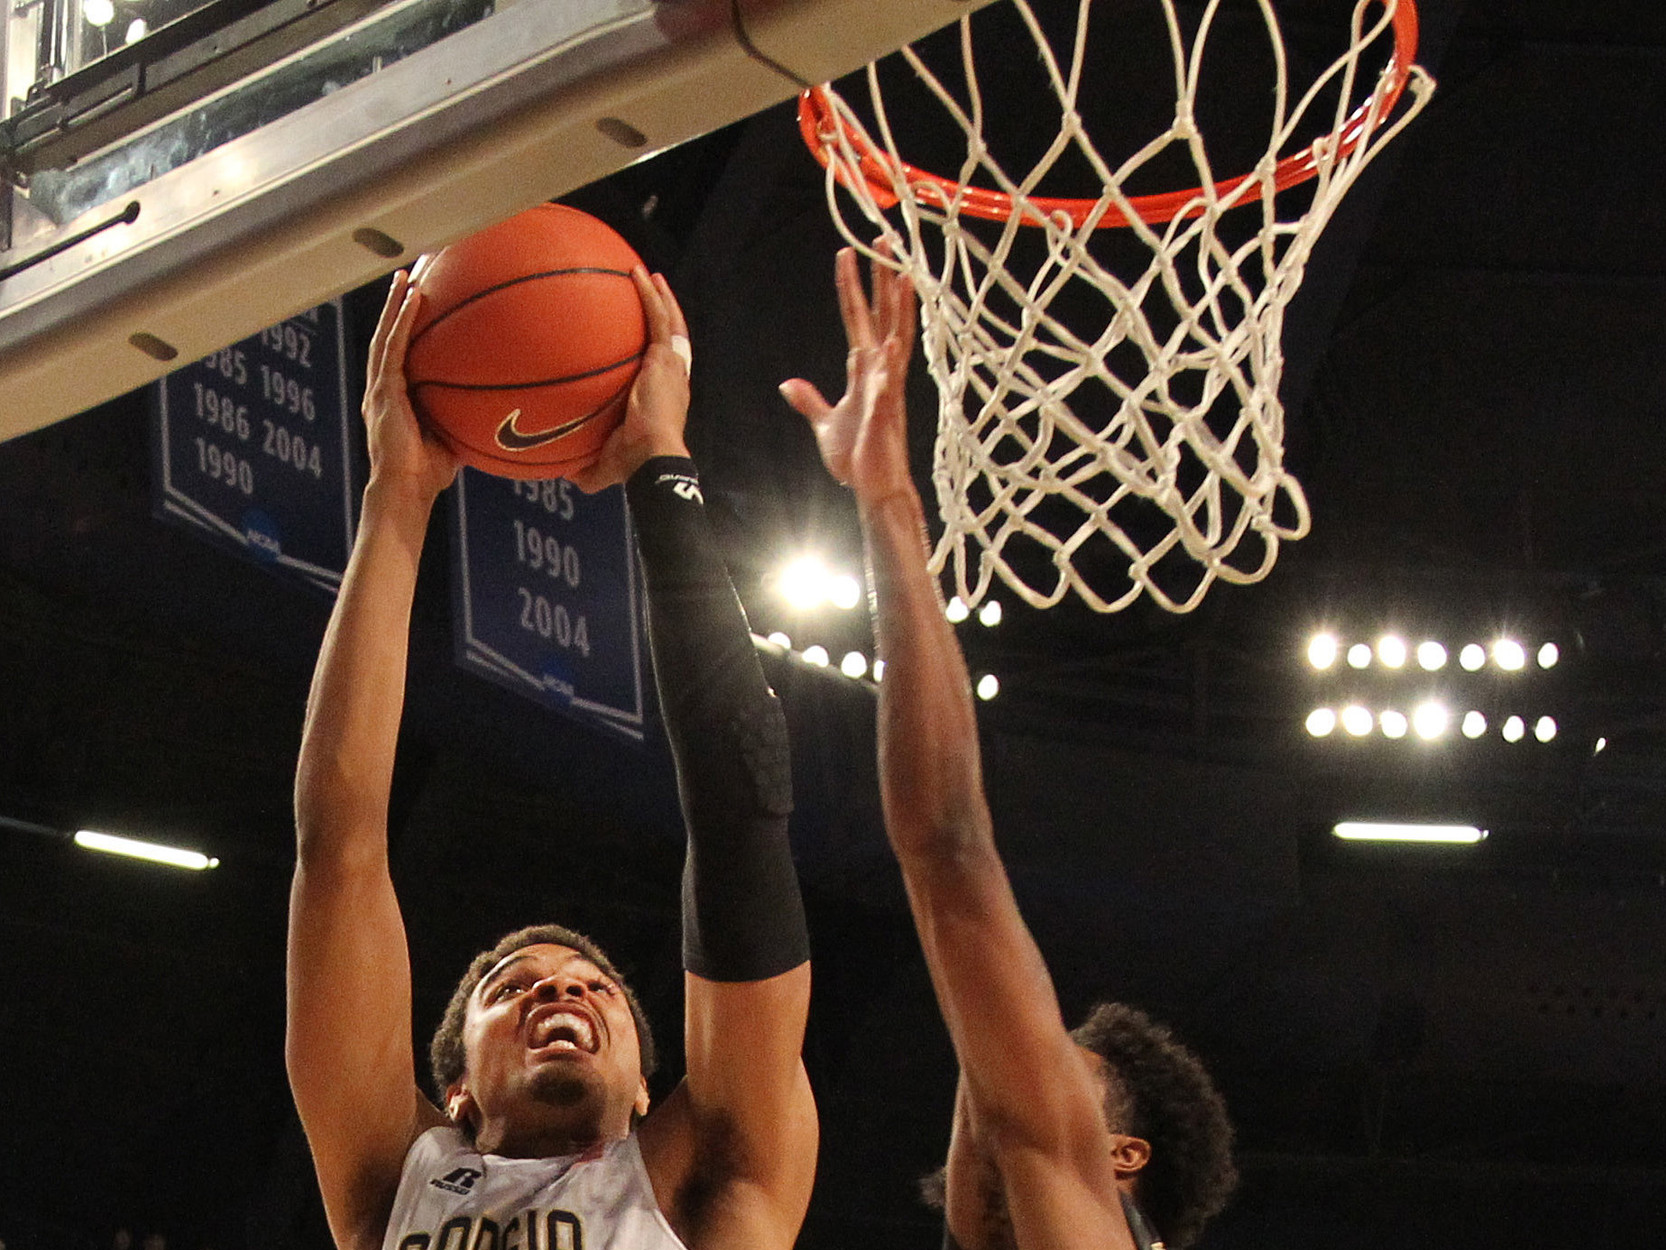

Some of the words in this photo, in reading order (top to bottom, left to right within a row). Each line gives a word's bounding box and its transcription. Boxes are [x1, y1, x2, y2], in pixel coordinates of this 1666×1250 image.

[261, 364, 316, 422] 1996
[193, 382, 250, 441] 1986
[262, 418, 323, 479] 2004
[196, 436, 254, 495] 1990
[513, 519, 580, 588] 1990
[517, 586, 591, 657] 2004
